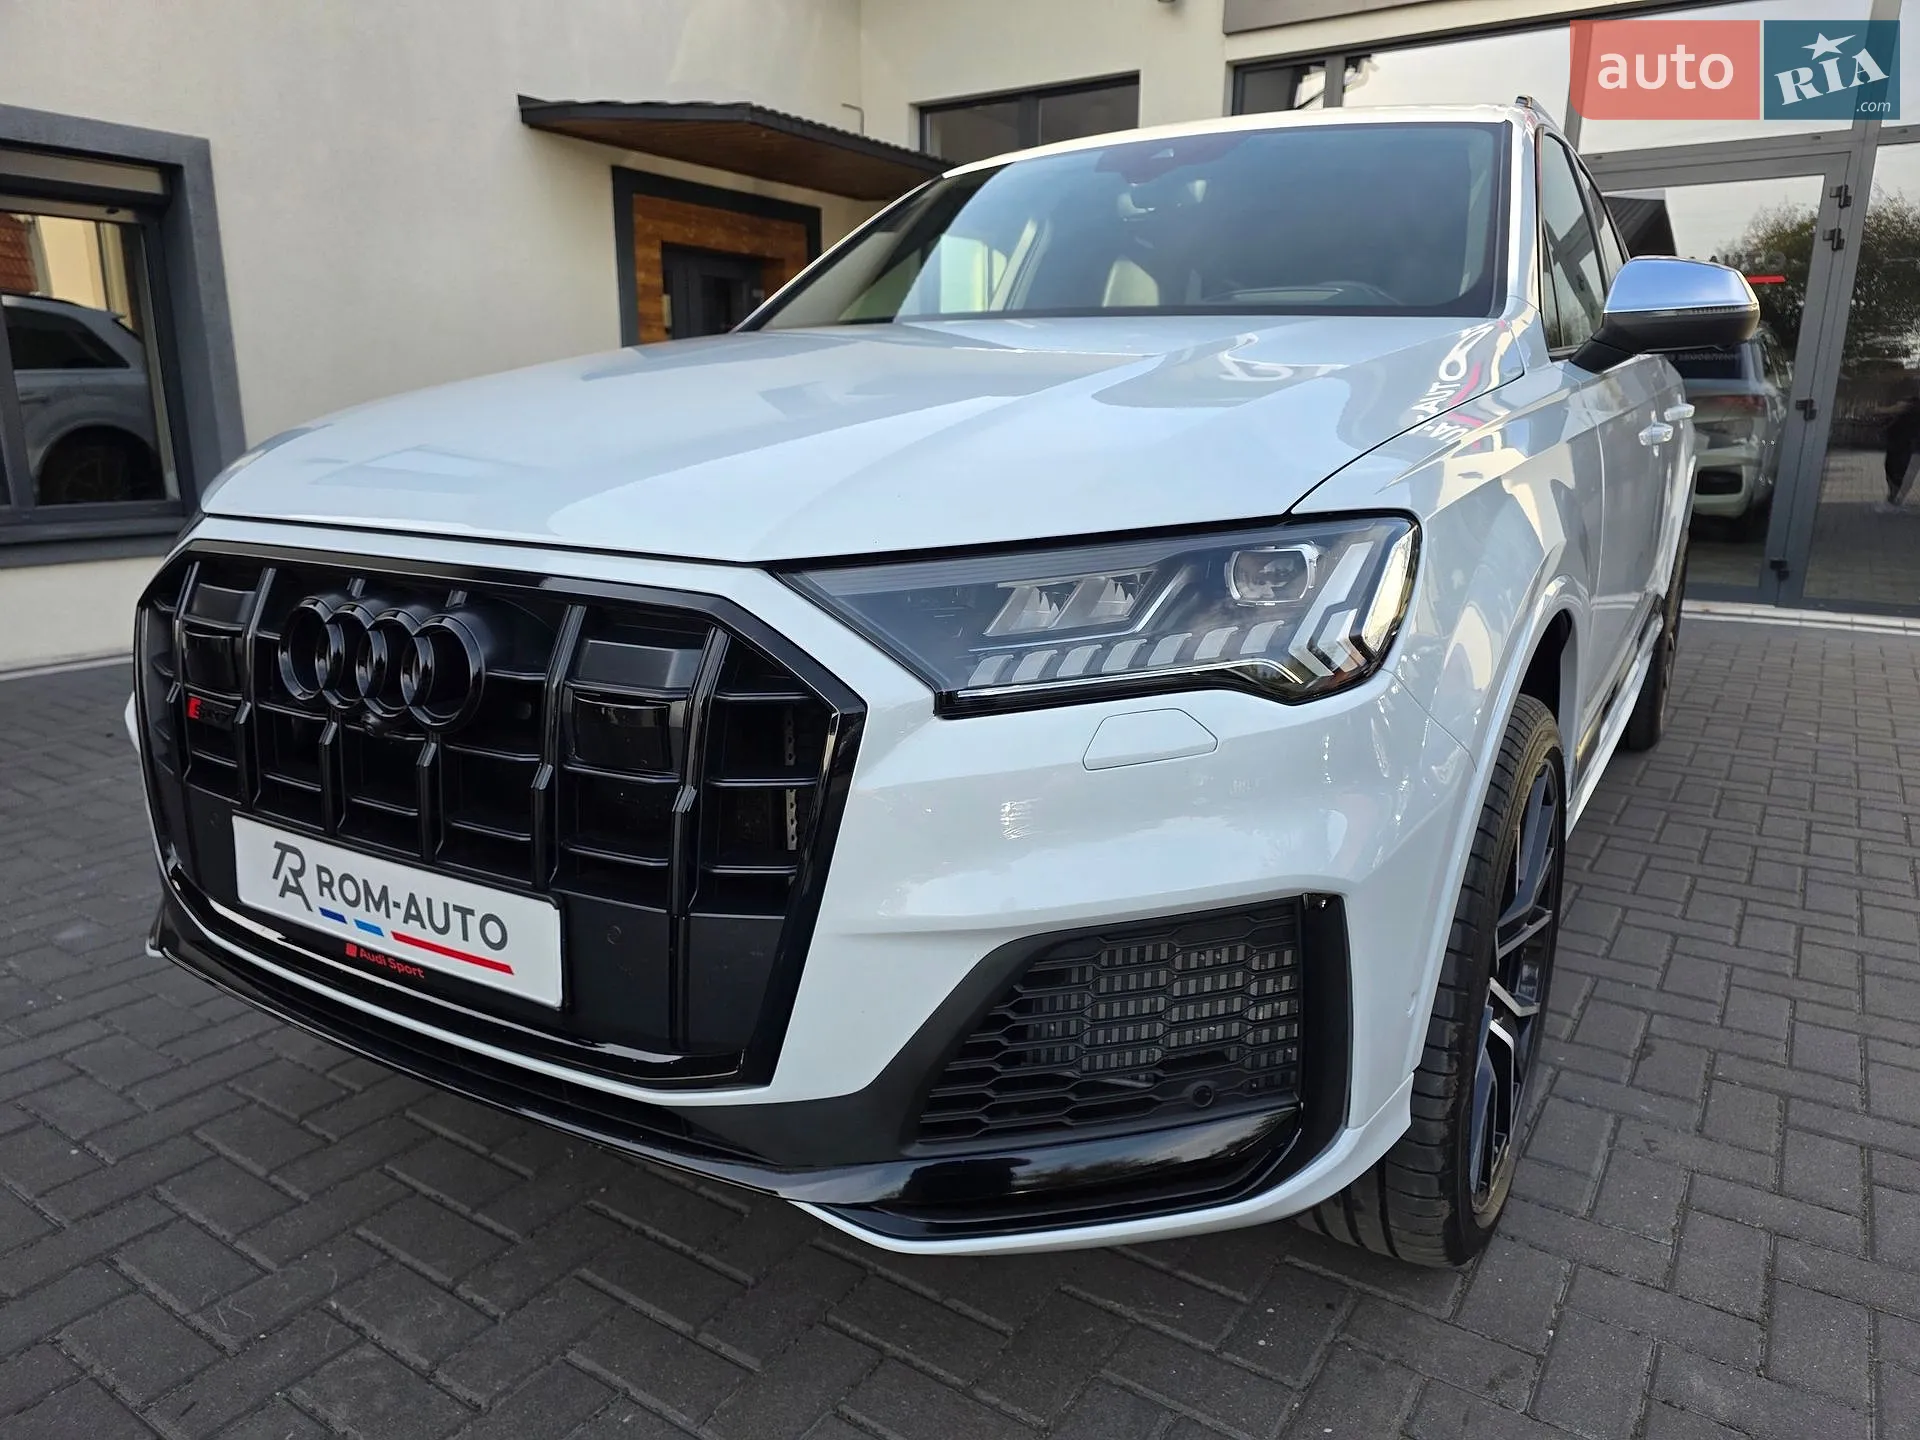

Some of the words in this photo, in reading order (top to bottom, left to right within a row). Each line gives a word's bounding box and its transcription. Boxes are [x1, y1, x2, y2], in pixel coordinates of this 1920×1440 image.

[316, 863, 508, 951] ROM-AUTO
[359, 947, 388, 966] Audi
[389, 957, 425, 979] Sport
